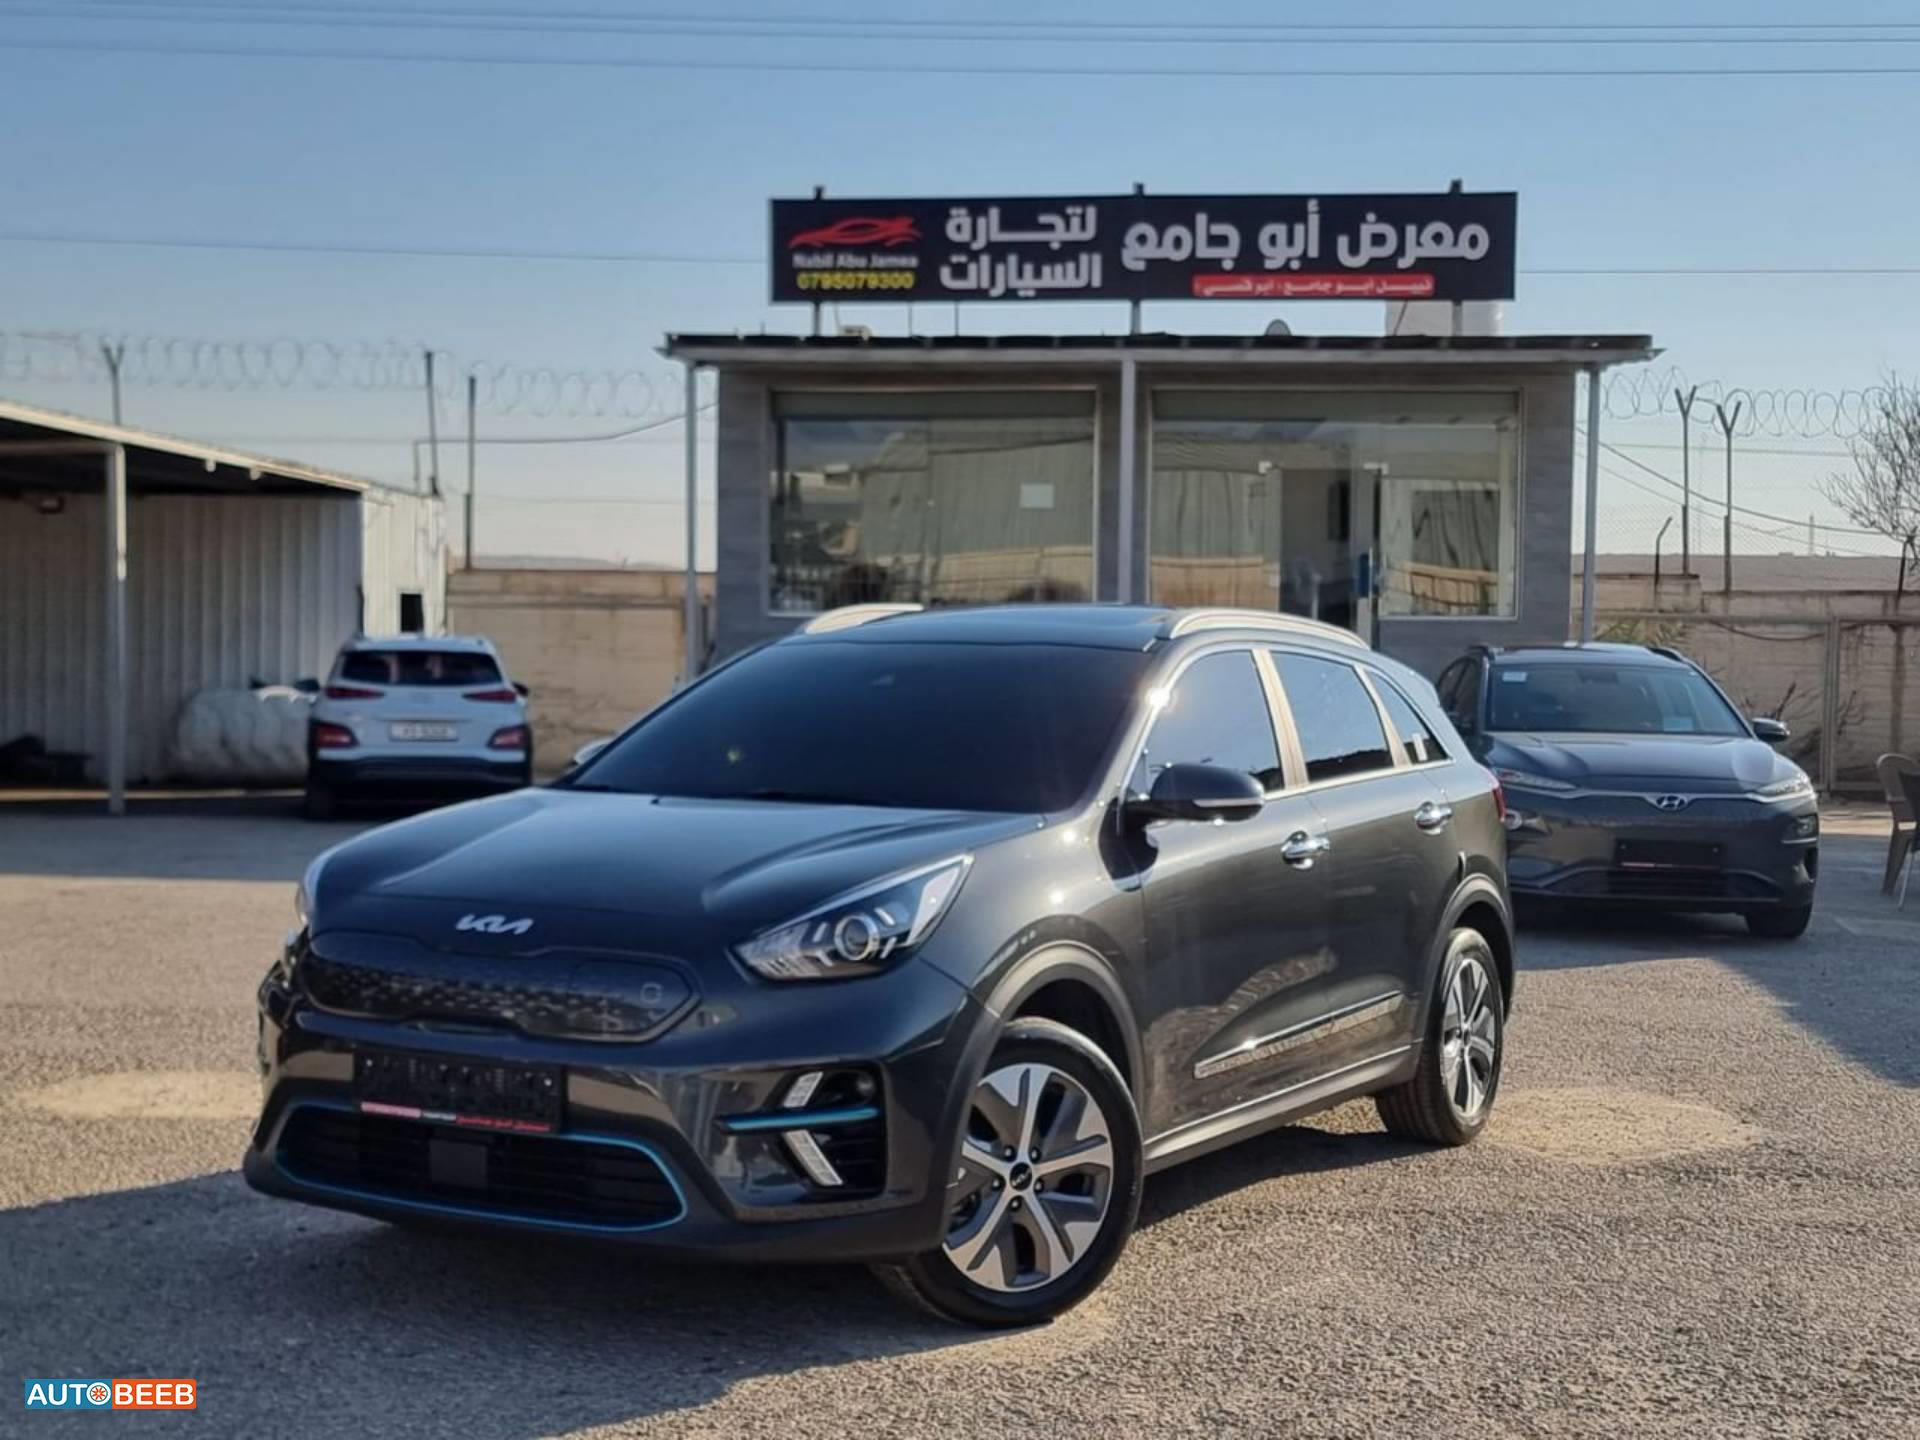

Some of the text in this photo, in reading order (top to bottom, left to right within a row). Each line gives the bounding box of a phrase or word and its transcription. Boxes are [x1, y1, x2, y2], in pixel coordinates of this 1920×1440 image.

[945, 206, 1097, 250] لتجارة
[1121, 199, 1490, 271] معرض أبو جامع
[939, 253, 1102, 298] السيارات
